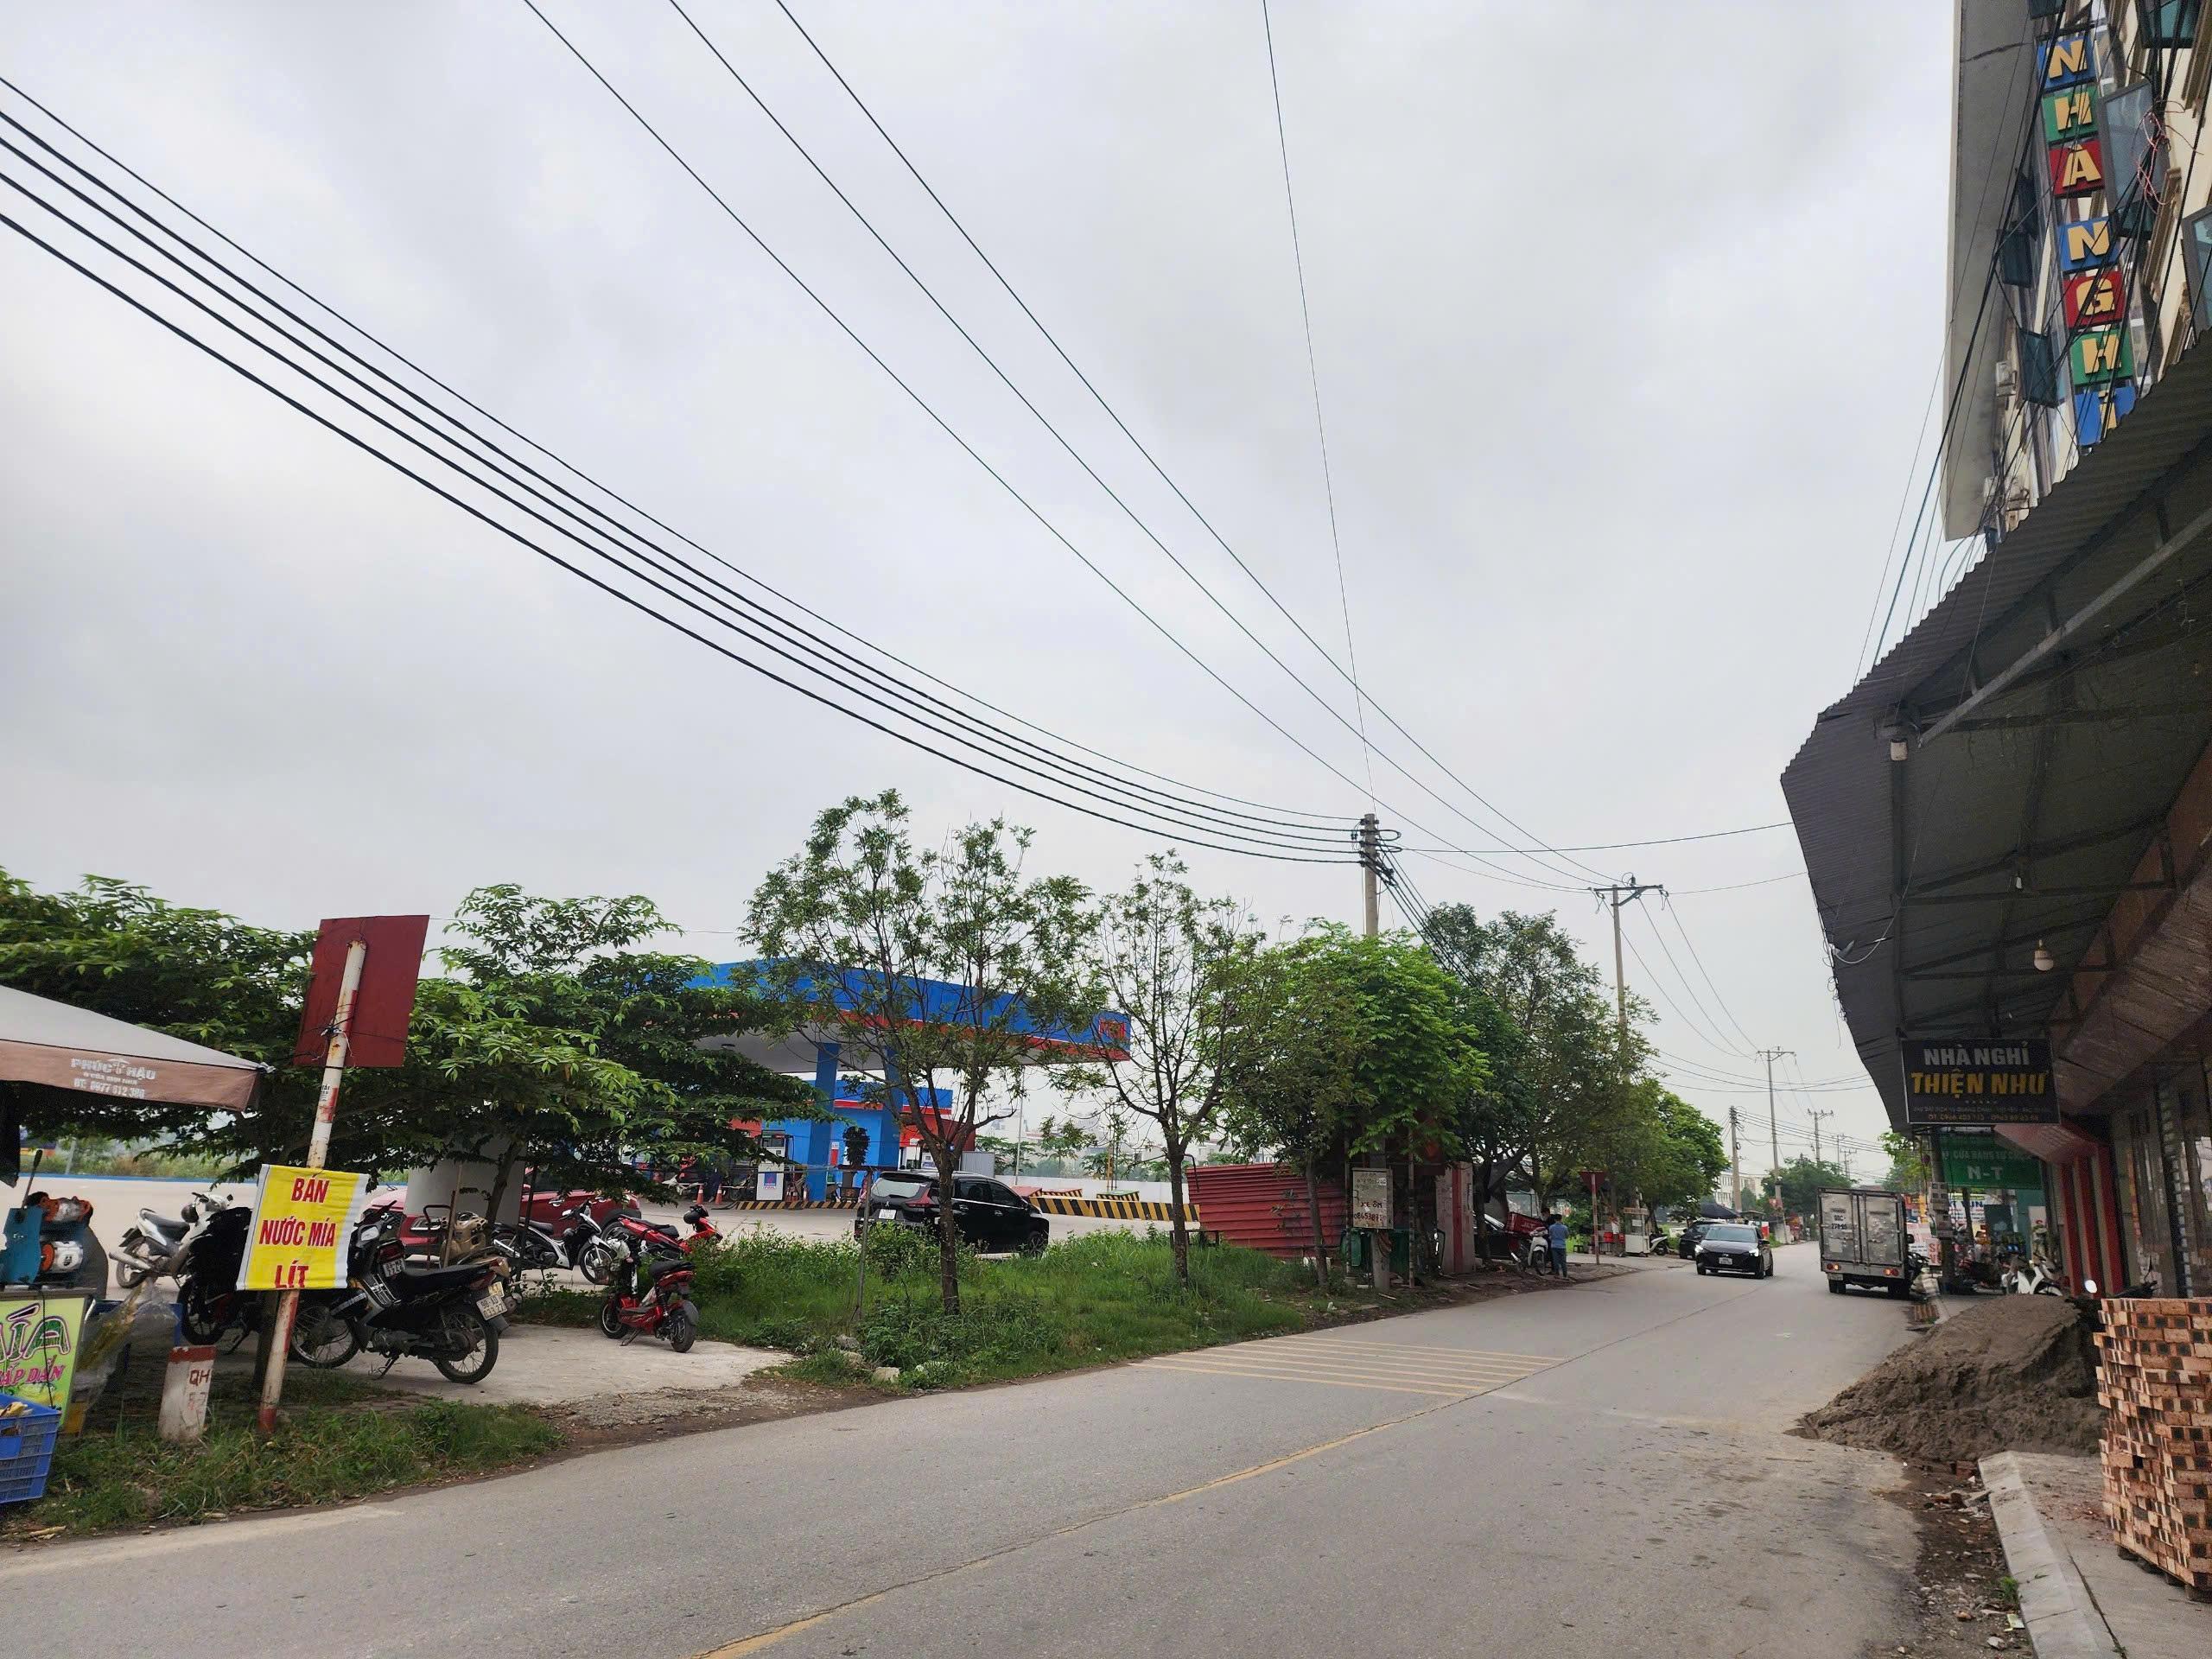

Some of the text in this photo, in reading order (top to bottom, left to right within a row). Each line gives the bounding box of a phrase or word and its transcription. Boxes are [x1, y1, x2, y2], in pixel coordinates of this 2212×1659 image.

[1923, 1040, 2030, 1065] NHÀ NGHỈ
[126, 1066, 156, 1080] HẬU
[1910, 1068, 2050, 1099] THIỆN NHƯ
[291, 1173, 330, 1204] BÁN
[259, 1215, 336, 1247] NƯỚC MÍA
[275, 1260, 309, 1288] LÍT
[0, 1303, 71, 1363] ÍA
[189, 1369, 211, 1387] QH
